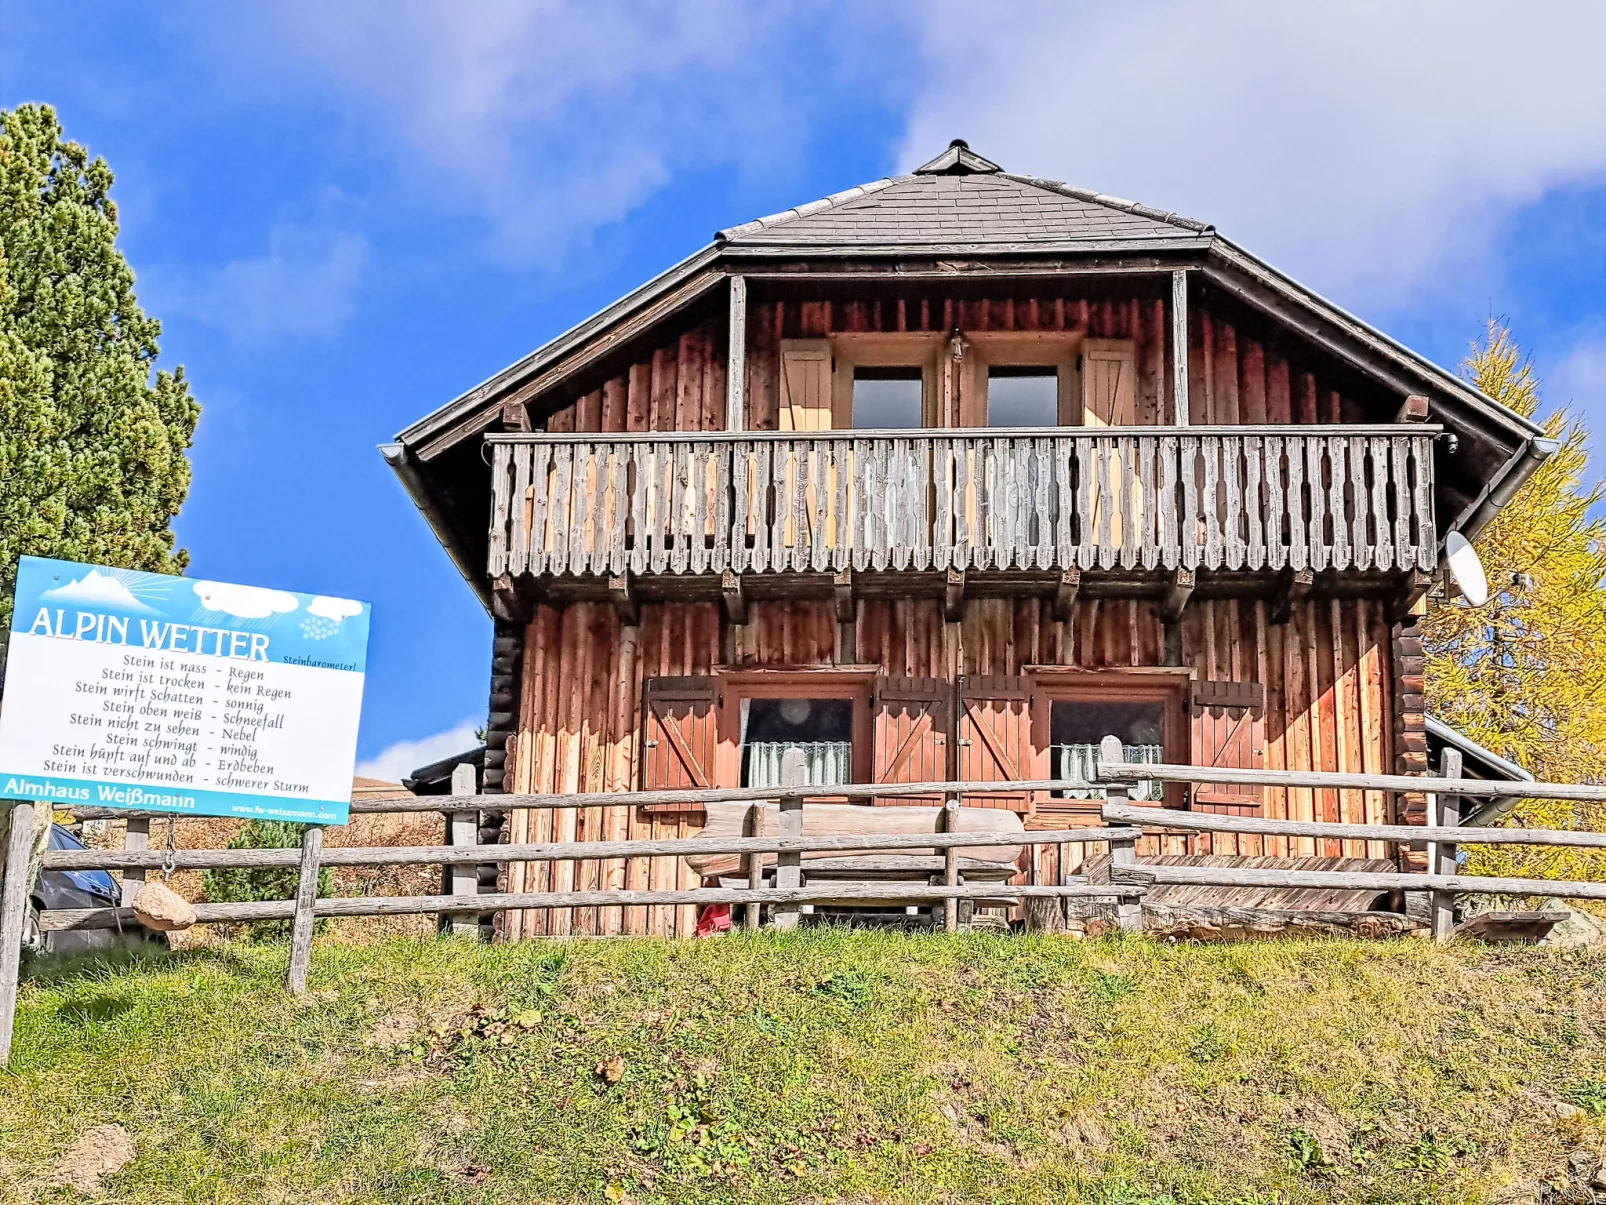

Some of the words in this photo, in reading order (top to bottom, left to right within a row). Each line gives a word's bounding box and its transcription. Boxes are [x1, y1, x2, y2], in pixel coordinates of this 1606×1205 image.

[28, 607, 130, 646] ALPIN
[140, 619, 270, 663] WETTER
[123, 655, 154, 668] Stein
[160, 657, 175, 670] ist
[180, 663, 207, 673] nass
[229, 667, 264, 682] Regen
[283, 655, 357, 671] Steinbarometer!
[75, 681, 107, 695] Stein
[113, 684, 146, 702] wirft
[150, 686, 203, 704] Schatten
[225, 699, 264, 715] sonnig
[102, 668, 133, 682] Stein
[139, 671, 154, 684] ist
[159, 673, 205, 689] trocken
[227, 678, 251, 694] kein
[257, 685, 291, 701] Regen
[70, 713, 102, 727] Stein
[108, 714, 139, 731] nicht
[144, 722, 161, 732] zu
[165, 720, 200, 736] sehen
[222, 726, 257, 742] Nebel
[103, 700, 135, 714] Stein
[139, 700, 167, 717] oben
[173, 708, 202, 720] weiß
[223, 710, 284, 731] Schneefall
[52, 744, 85, 758] Stein
[90, 743, 124, 764] hüpft
[129, 749, 152, 767] auf
[154, 754, 177, 766] und
[182, 753, 196, 767] ab
[217, 758, 274, 775] Erdbeben
[106, 733, 138, 746] Stein
[142, 733, 198, 755] schwingt
[220, 744, 258, 760] windig
[43, 760, 76, 773] Stein
[82, 762, 97, 775] ist
[103, 764, 194, 783] verschwunden
[215, 772, 269, 790] schwerer
[273, 780, 309, 793] Sturm
[3, 778, 90, 799] Almhaus
[97, 785, 195, 809] Weißmann
